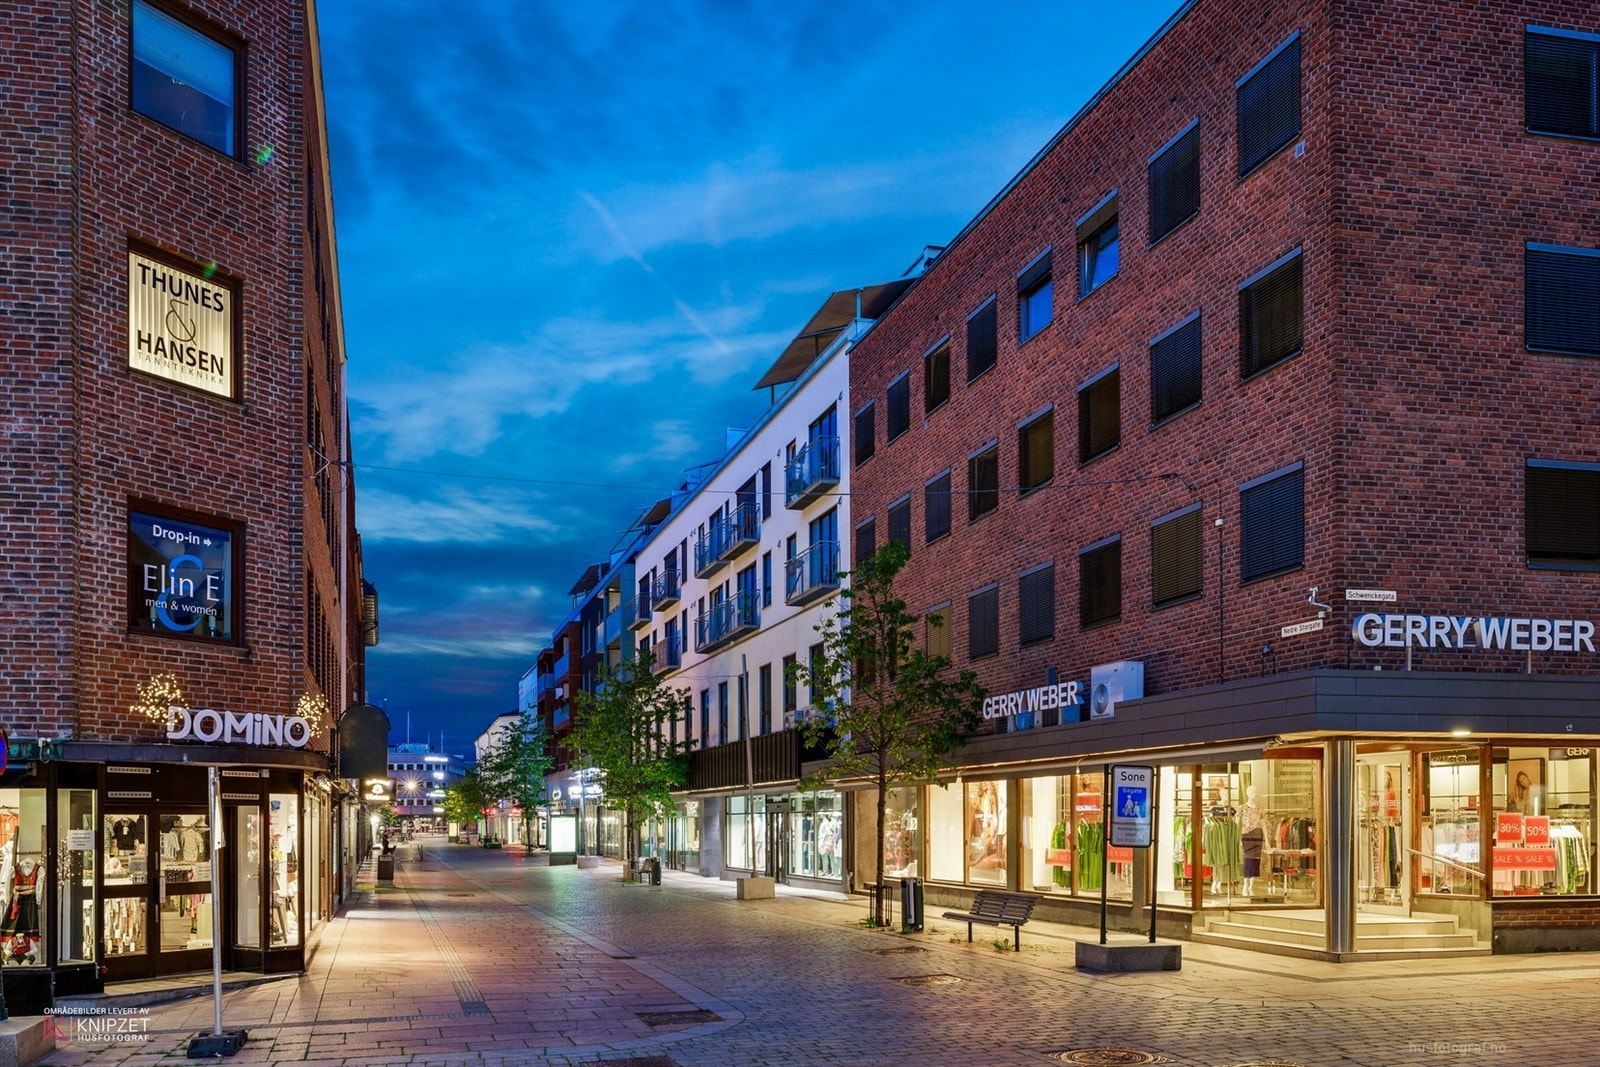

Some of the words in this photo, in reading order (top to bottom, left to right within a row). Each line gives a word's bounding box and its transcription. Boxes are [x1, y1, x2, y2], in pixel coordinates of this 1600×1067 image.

[138, 262, 224, 312] THUNES
[165, 299, 197, 346] &
[137, 330, 224, 377] HANSEN
[137, 351, 224, 385] TANNTEKNIKK
[152, 524, 200, 545] Drop-in
[143, 564, 194, 598] Elin
[206, 574, 220, 602] E
[1348, 591, 1395, 600] Schwenckegata
[145, 598, 168, 609] men
[170, 600, 179, 611] &
[181, 603, 218, 616] women
[1299, 622, 1321, 632] Storgate
[1354, 613, 1472, 649] GERRY
[1476, 616, 1596, 652] WEBER
[982, 691, 1025, 720] GERRY
[1026, 681, 1079, 712] WEBER
[1120, 771, 1146, 782] Sone
[1499, 822, 1521, 834] 30%
[1526, 825, 1548, 837] 50%
[1493, 855, 1512, 863] SALE
[1515, 855, 1522, 863] %
[1525, 855, 1543, 863] SALE
[1546, 855, 1553, 863] %
